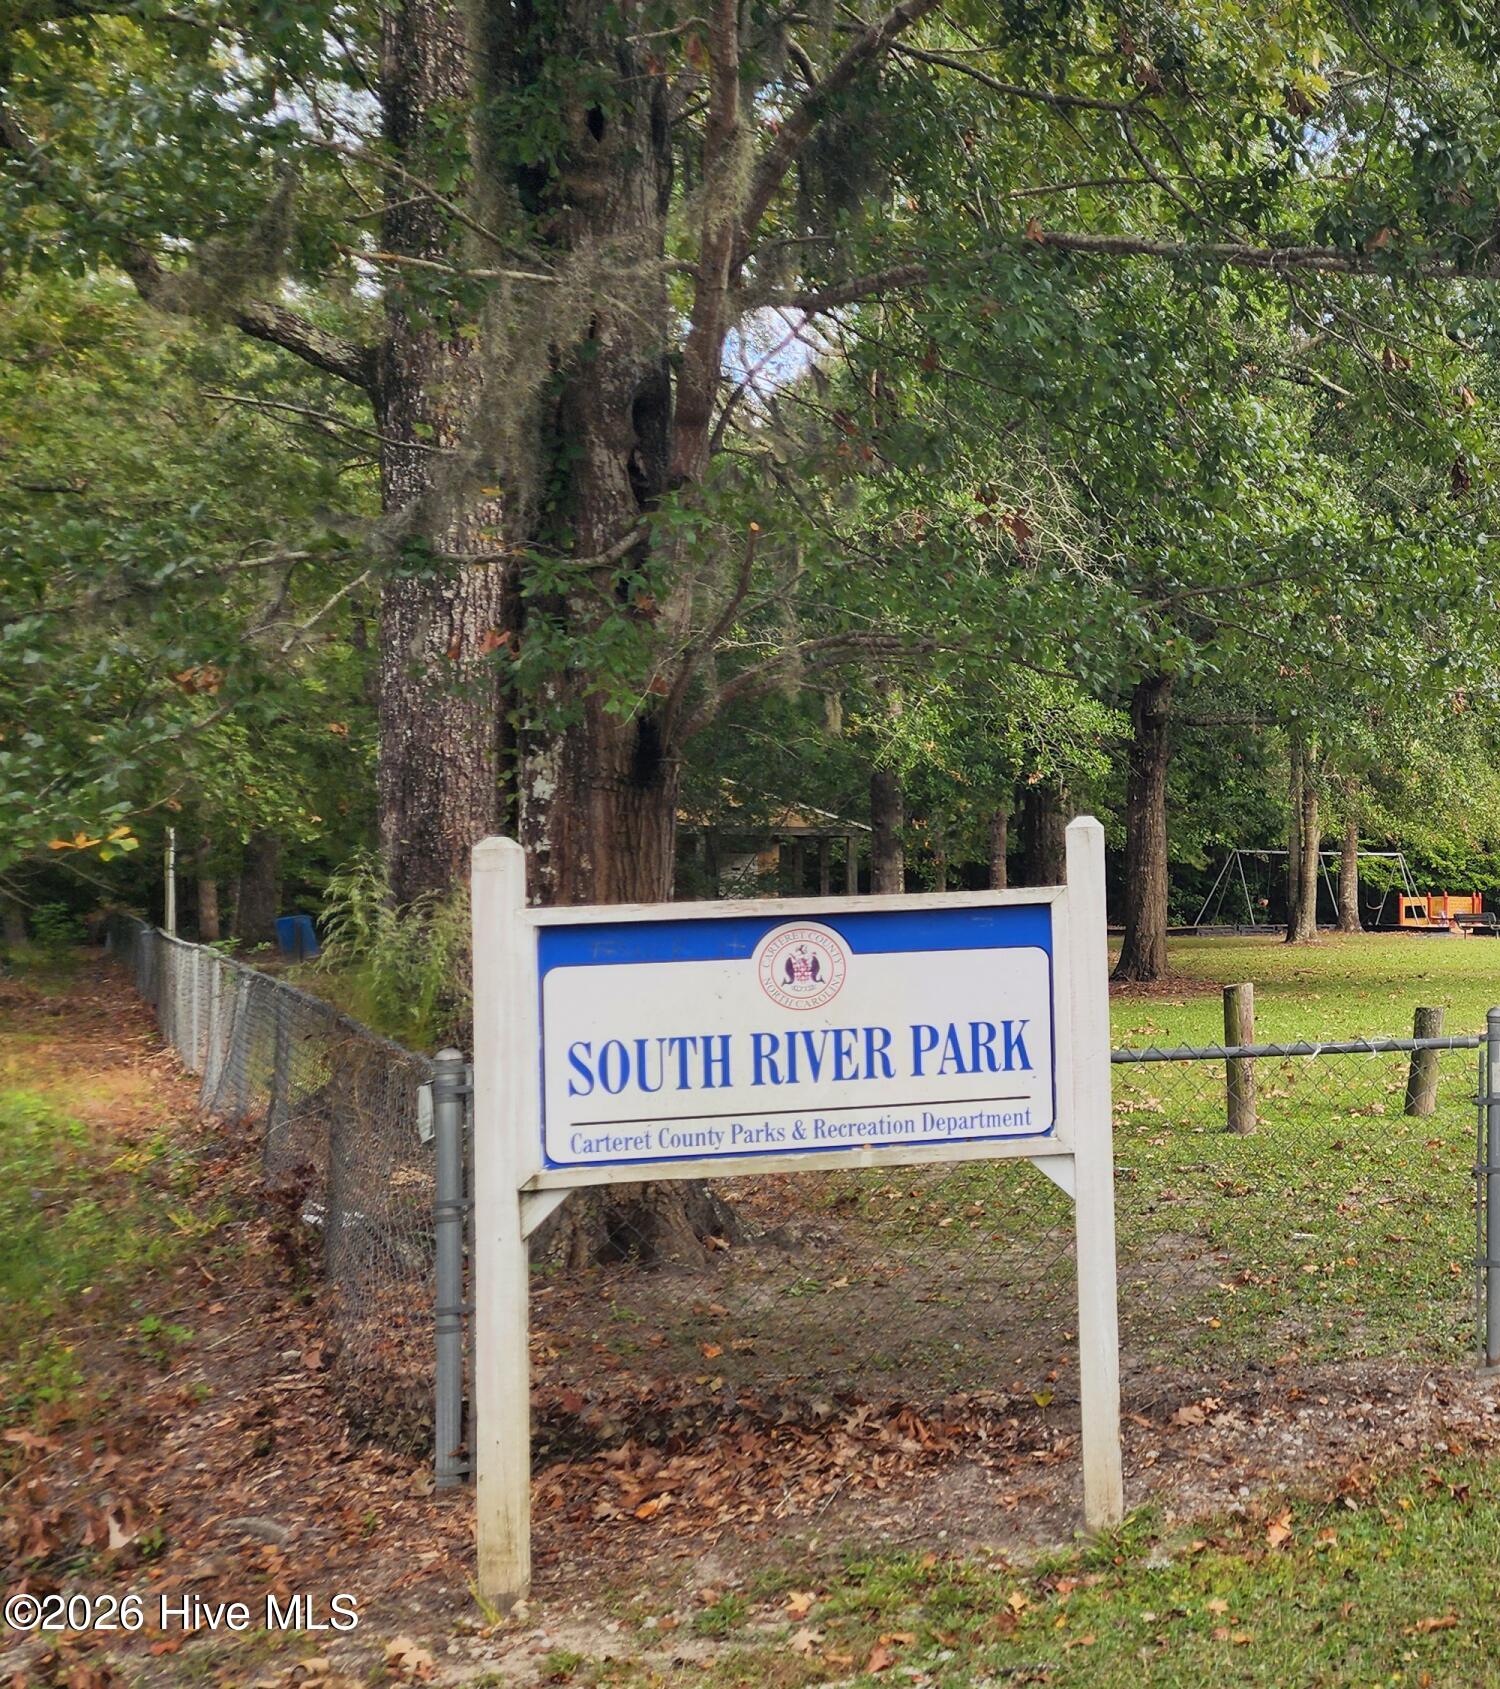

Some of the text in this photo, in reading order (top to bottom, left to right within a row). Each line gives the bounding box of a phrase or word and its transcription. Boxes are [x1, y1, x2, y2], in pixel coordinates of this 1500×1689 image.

[763, 931, 842, 968] CARTERET COUNTY
[764, 973, 843, 1008] NORTH CAROLINA
[568, 1018, 1033, 1097] SOUTH RIVER PARK
[570, 1106, 1032, 1154] Carteret County Parks & Recreation Department
